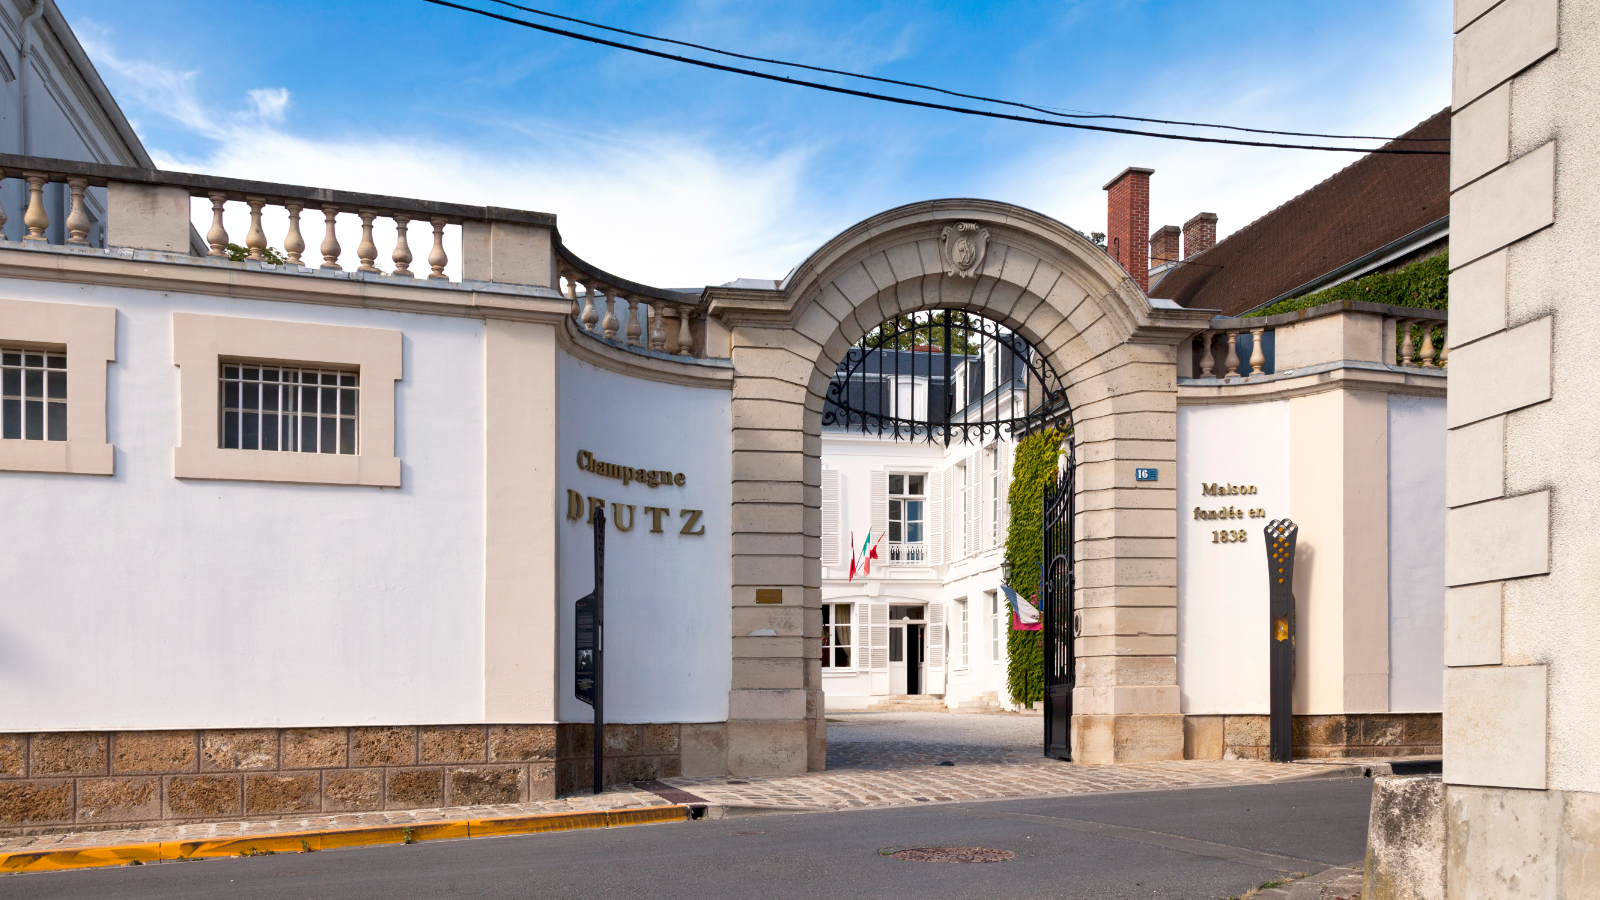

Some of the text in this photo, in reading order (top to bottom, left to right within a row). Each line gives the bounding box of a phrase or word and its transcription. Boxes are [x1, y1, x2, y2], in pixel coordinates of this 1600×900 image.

[577, 450, 686, 487] Champagne
[1138, 469, 1149, 479] 16
[1201, 482, 1257, 496] Maison
[567, 489, 705, 534] DEUTZ
[1193, 505, 1265, 519] fondée en
[1211, 529, 1247, 543] 1838
